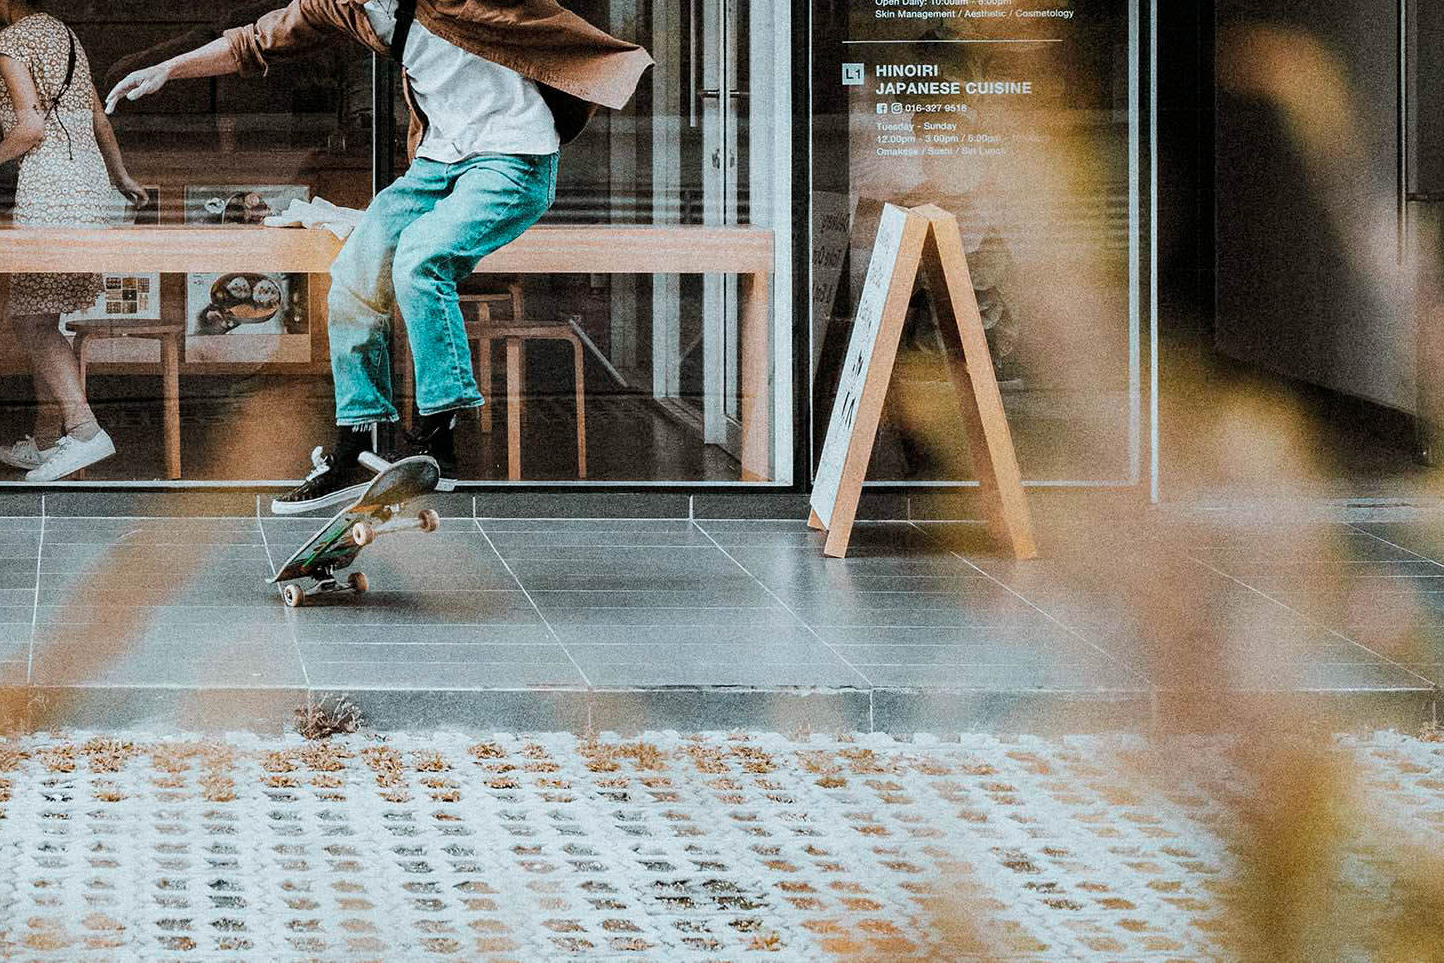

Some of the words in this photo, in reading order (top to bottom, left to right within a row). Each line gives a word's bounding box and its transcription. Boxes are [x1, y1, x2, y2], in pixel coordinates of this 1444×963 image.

[875, 9, 895, 18] Skin
[897, 10, 956, 19] Management
[964, 9, 1006, 18] Aesthetic
[1015, 8, 1074, 19] Cosmetology
[845, 68, 861, 80] L1
[876, 64, 938, 77] HINOIRI
[875, 82, 961, 95] JAPANESE
[965, 81, 1032, 95] CUISINE
[905, 104, 942, 112] 016-327
[876, 122, 914, 132] Tuesday
[923, 121, 957, 131] Sunday
